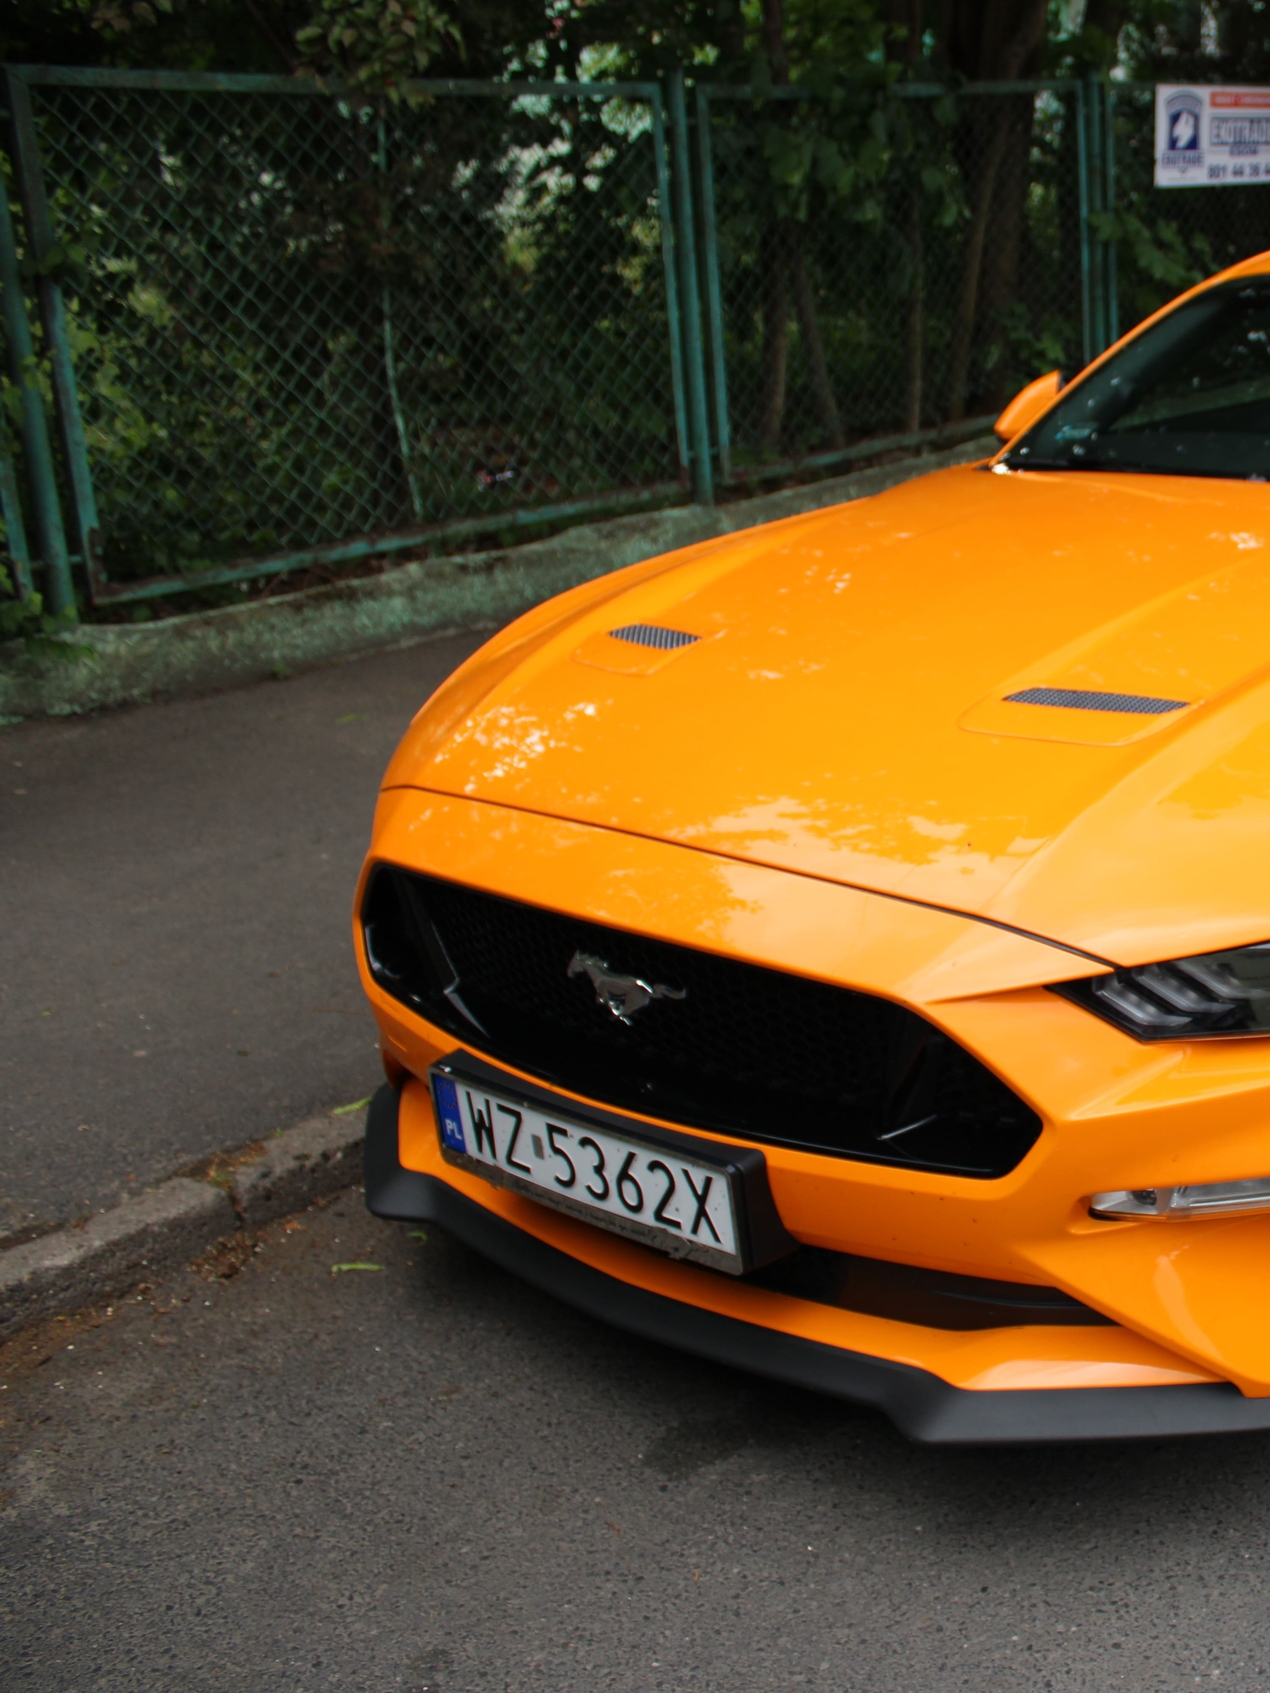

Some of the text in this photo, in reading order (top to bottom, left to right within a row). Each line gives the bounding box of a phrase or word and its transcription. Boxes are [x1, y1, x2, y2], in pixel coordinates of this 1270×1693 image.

[444, 1118, 463, 1140] PL
[465, 1090, 532, 1175] WZ
[545, 1121, 722, 1244] 5362X
